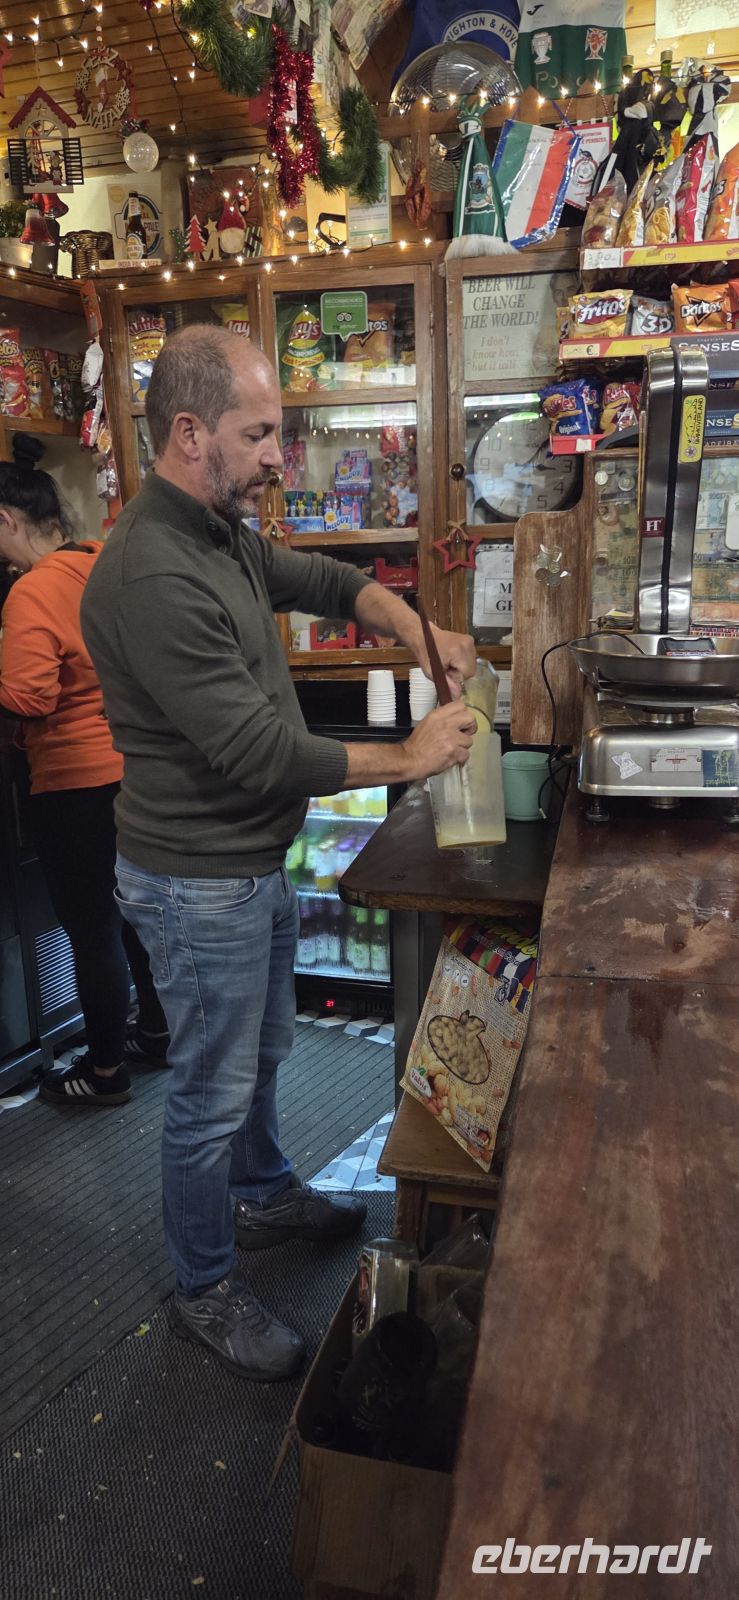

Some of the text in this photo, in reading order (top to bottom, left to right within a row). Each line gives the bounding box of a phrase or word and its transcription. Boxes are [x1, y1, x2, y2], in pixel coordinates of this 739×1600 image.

[446, 16, 517, 48] IGHTON & HOVE
[467, 275, 536, 294] BEER WILL
[472, 293, 526, 311] CHANGE
[681, 301, 722, 318] Doritos
[463, 311, 539, 330] THE WORLD!
[480, 336, 486, 347] I
[562, 460, 573, 473] 3
[553, 481, 564, 494] 4
[537, 495, 547, 508] 5
